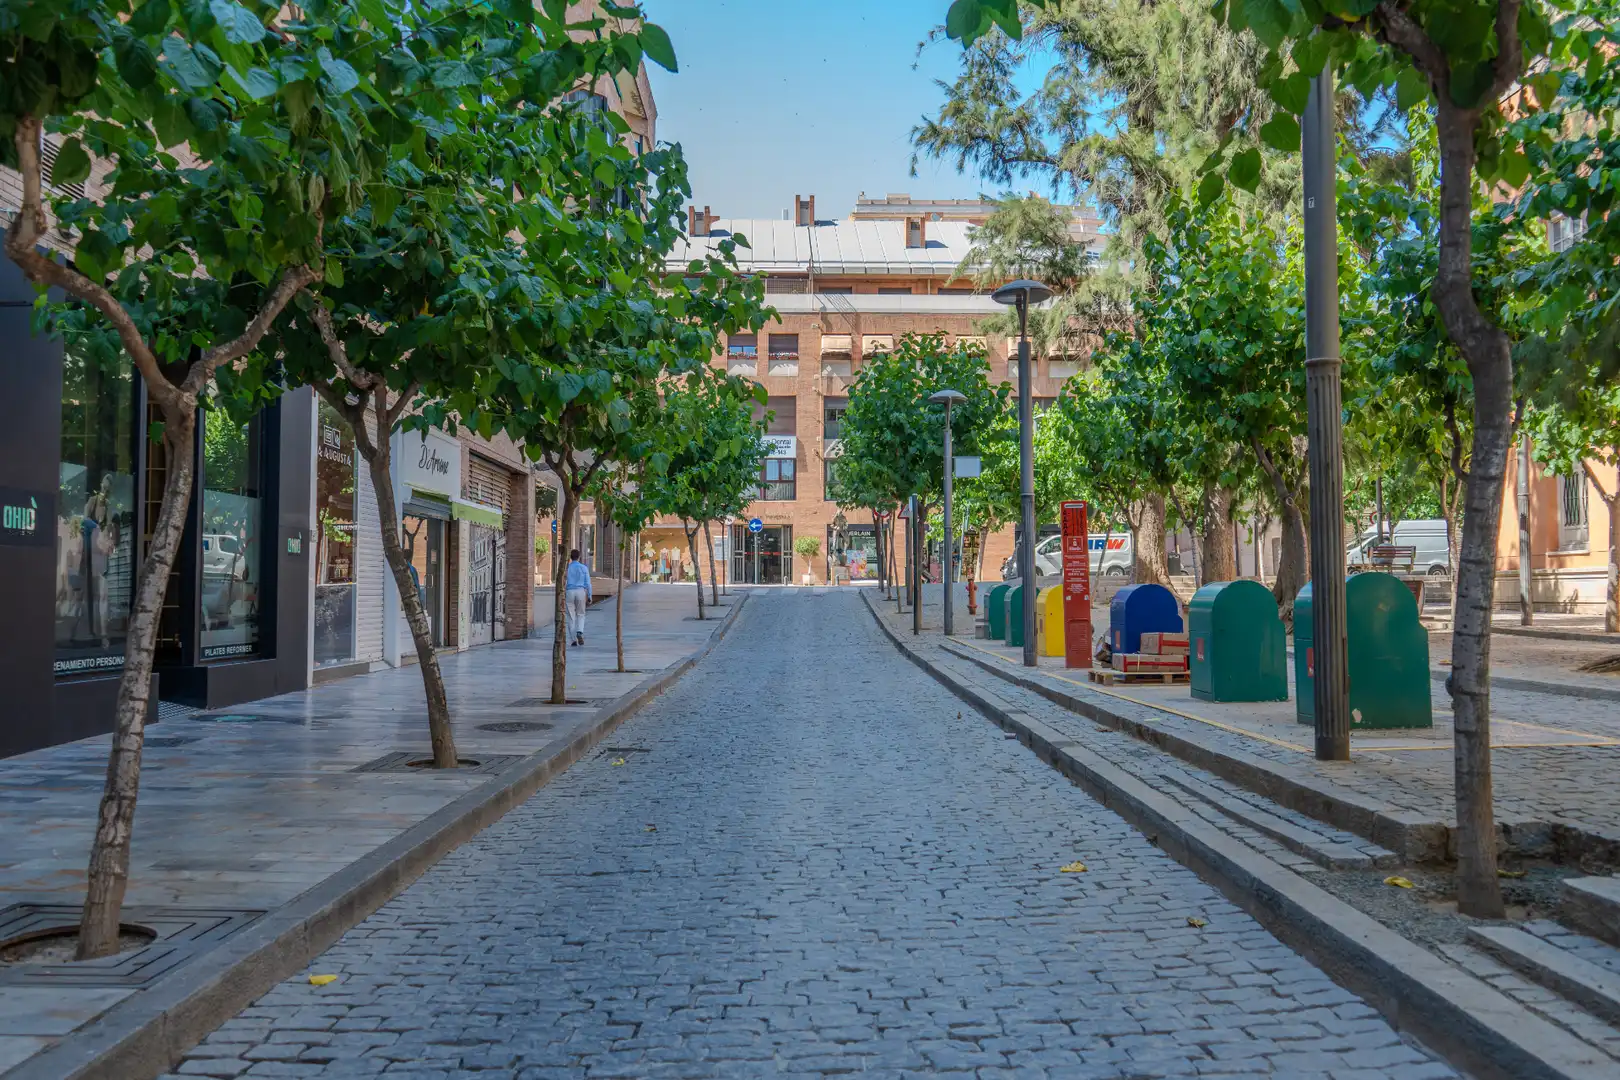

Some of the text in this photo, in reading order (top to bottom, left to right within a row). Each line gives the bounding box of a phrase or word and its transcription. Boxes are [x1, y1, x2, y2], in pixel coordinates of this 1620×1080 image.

[323, 447, 352, 468] AUGUSTA
[204, 645, 253, 656] PILATES REFORMER
[53, 658, 95, 671] ENAMIENTO
